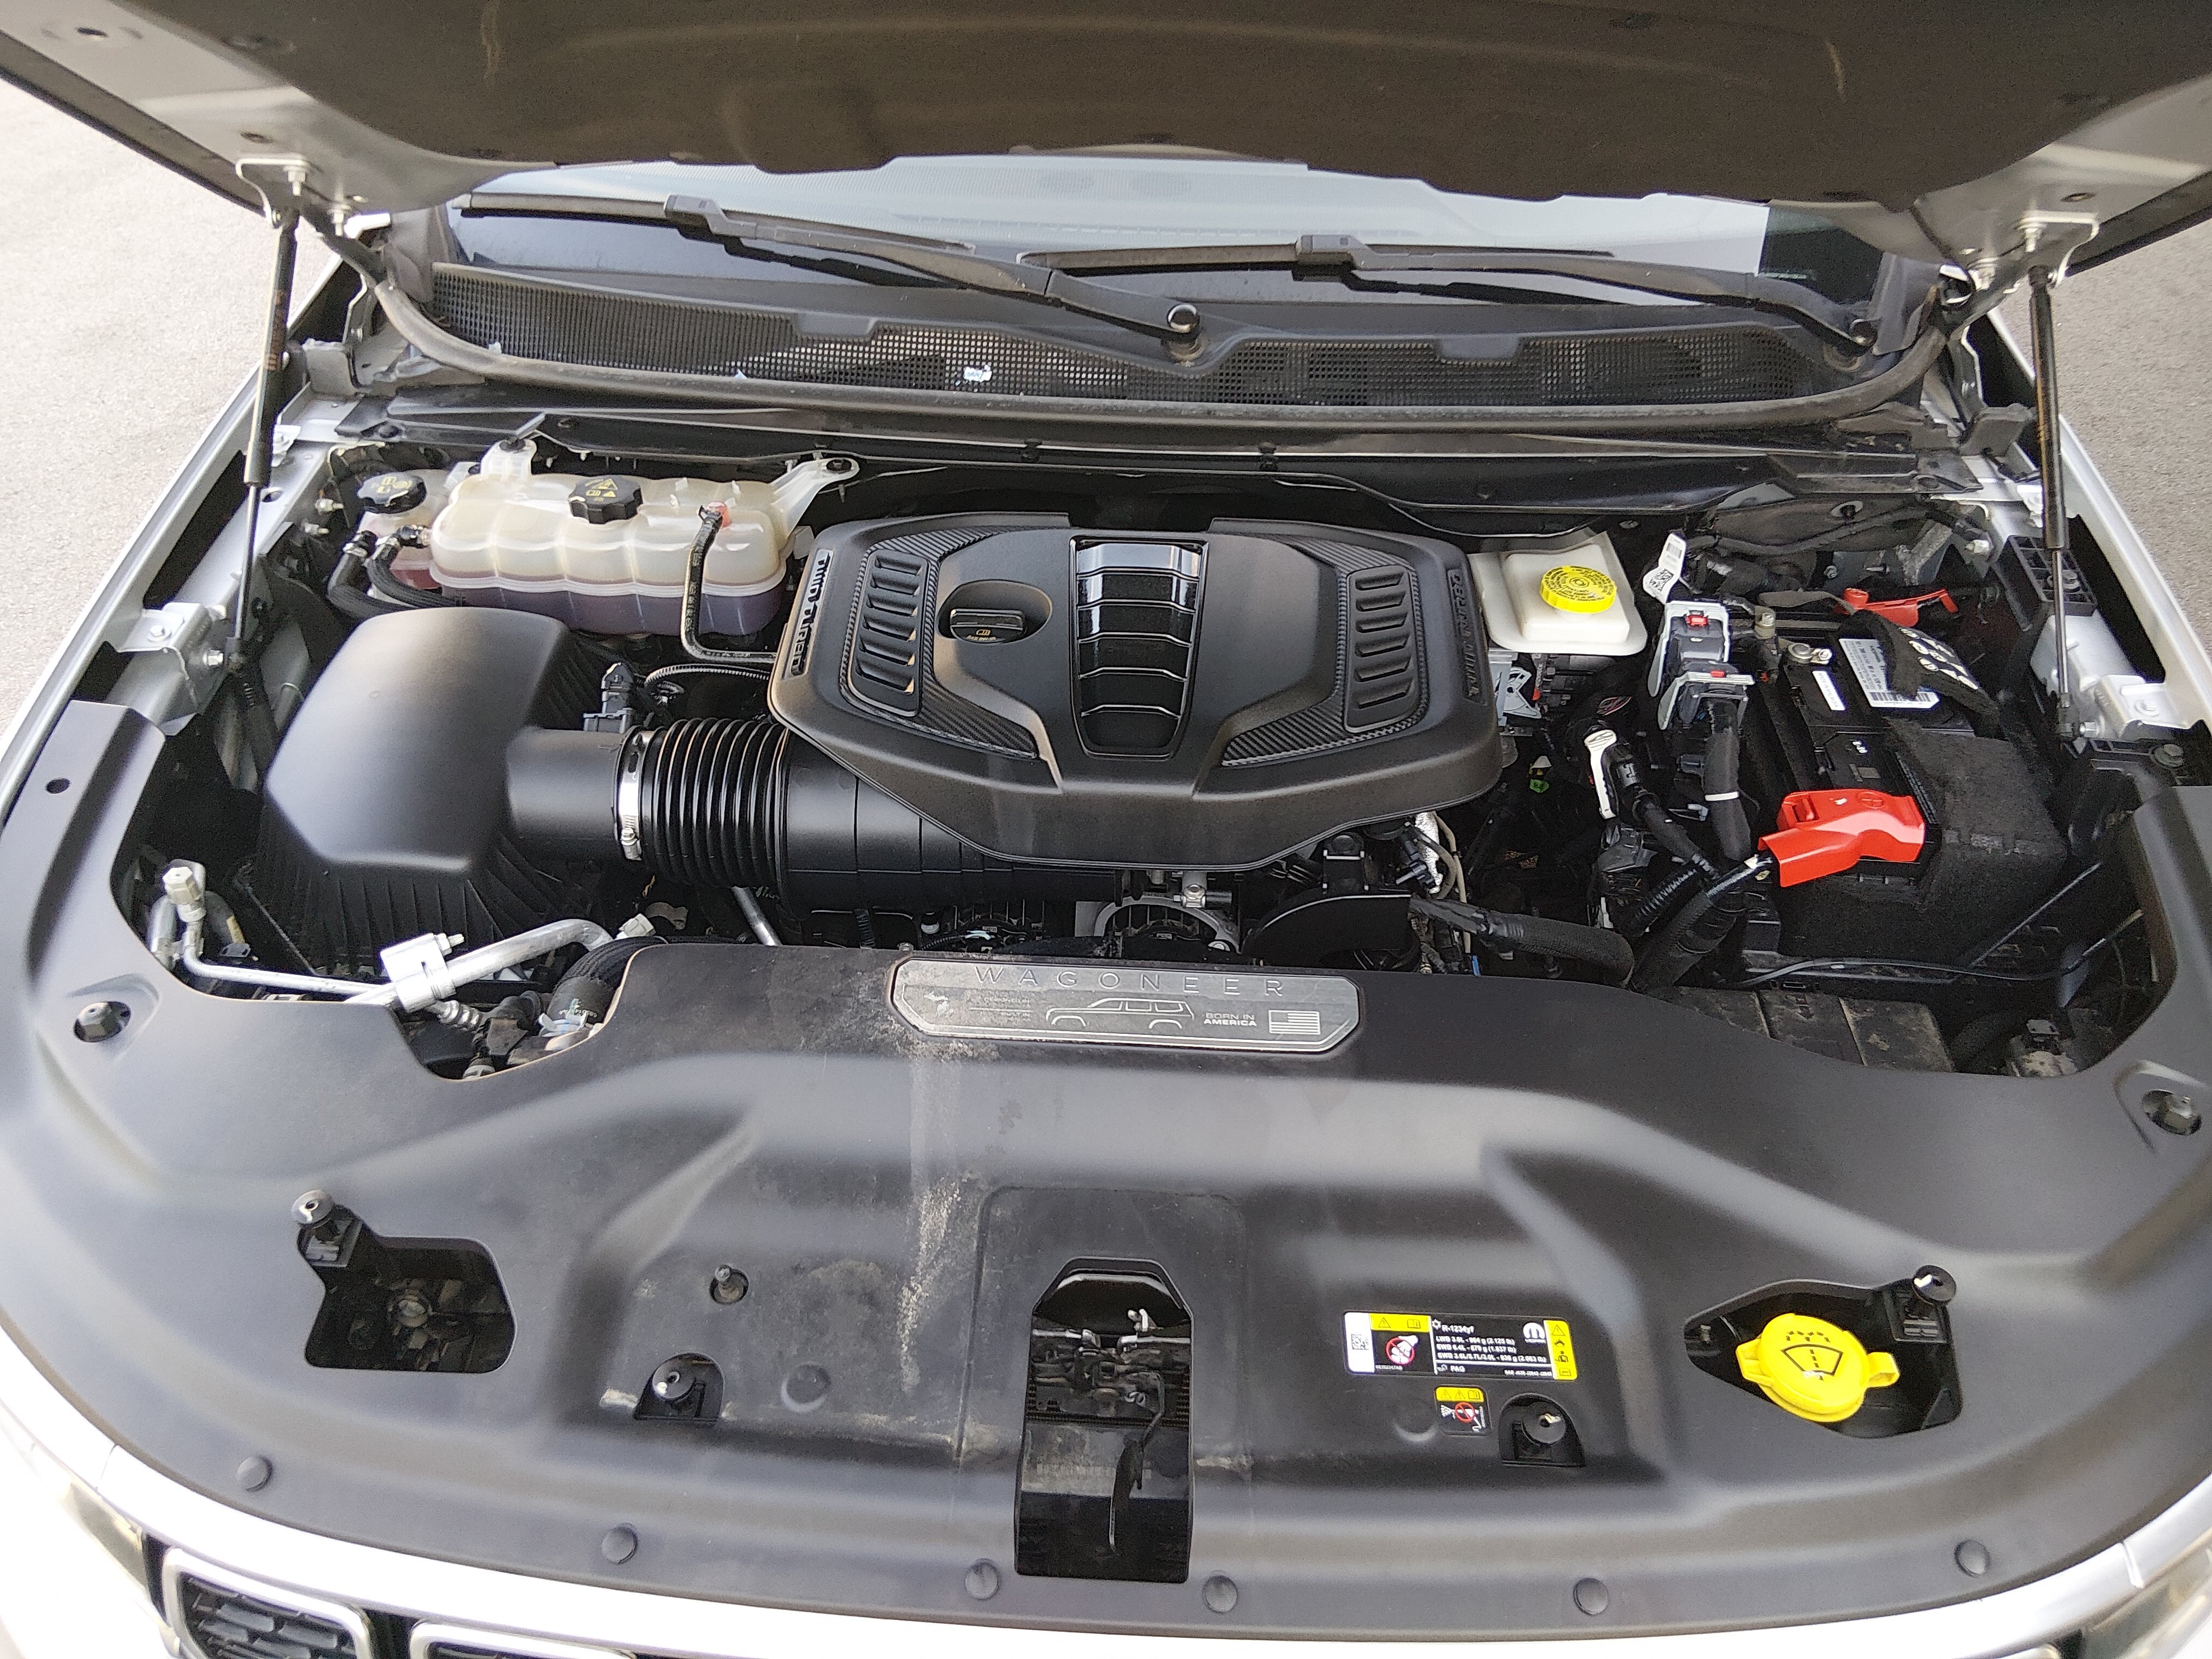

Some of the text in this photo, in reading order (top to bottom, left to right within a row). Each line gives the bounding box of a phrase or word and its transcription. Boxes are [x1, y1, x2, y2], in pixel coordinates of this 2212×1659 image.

[790, 602, 818, 676] TURBO
[974, 965, 1283, 997] WAGONEER
[1203, 1018, 1258, 1027] AMERICA
